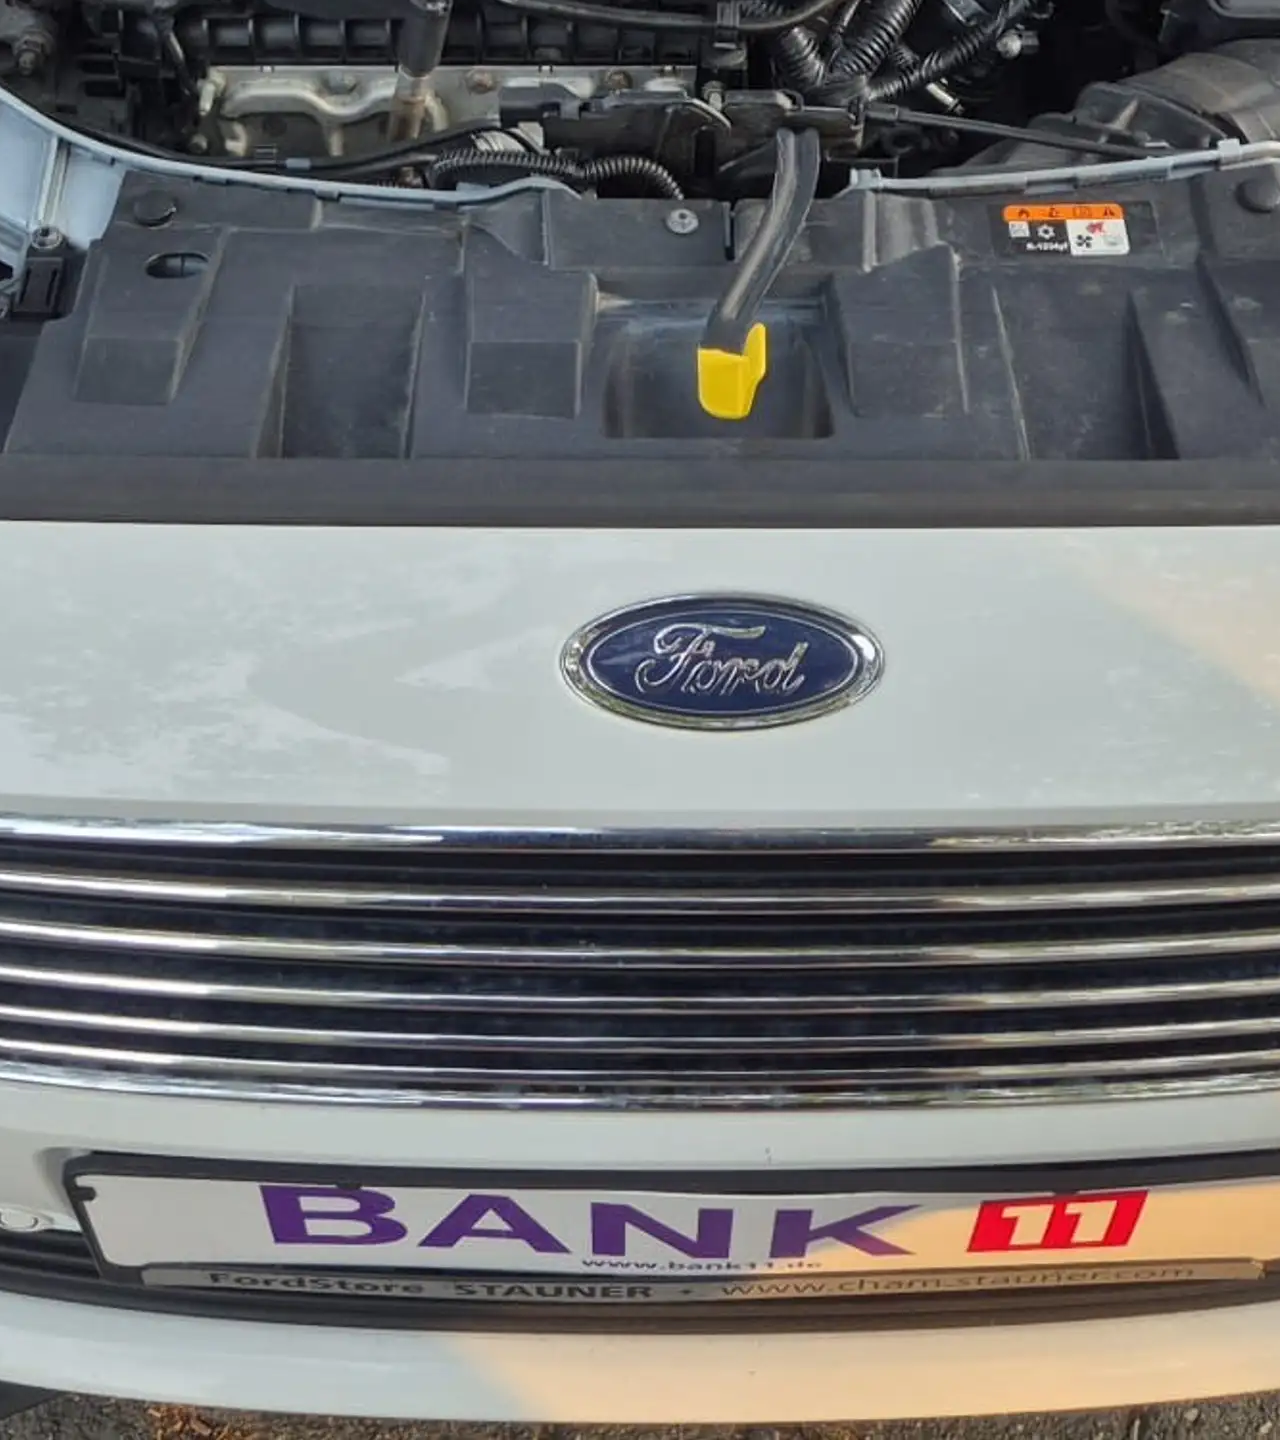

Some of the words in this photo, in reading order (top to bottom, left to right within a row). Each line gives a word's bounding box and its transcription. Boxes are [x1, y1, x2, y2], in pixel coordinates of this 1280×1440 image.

[633, 622, 809, 696] Ford
[258, 1183, 924, 1259] BANK
[1001, 1197, 1119, 1248] 11
[207, 1271, 424, 1294] FordStore
[454, 1283, 654, 1299] STAUNER
